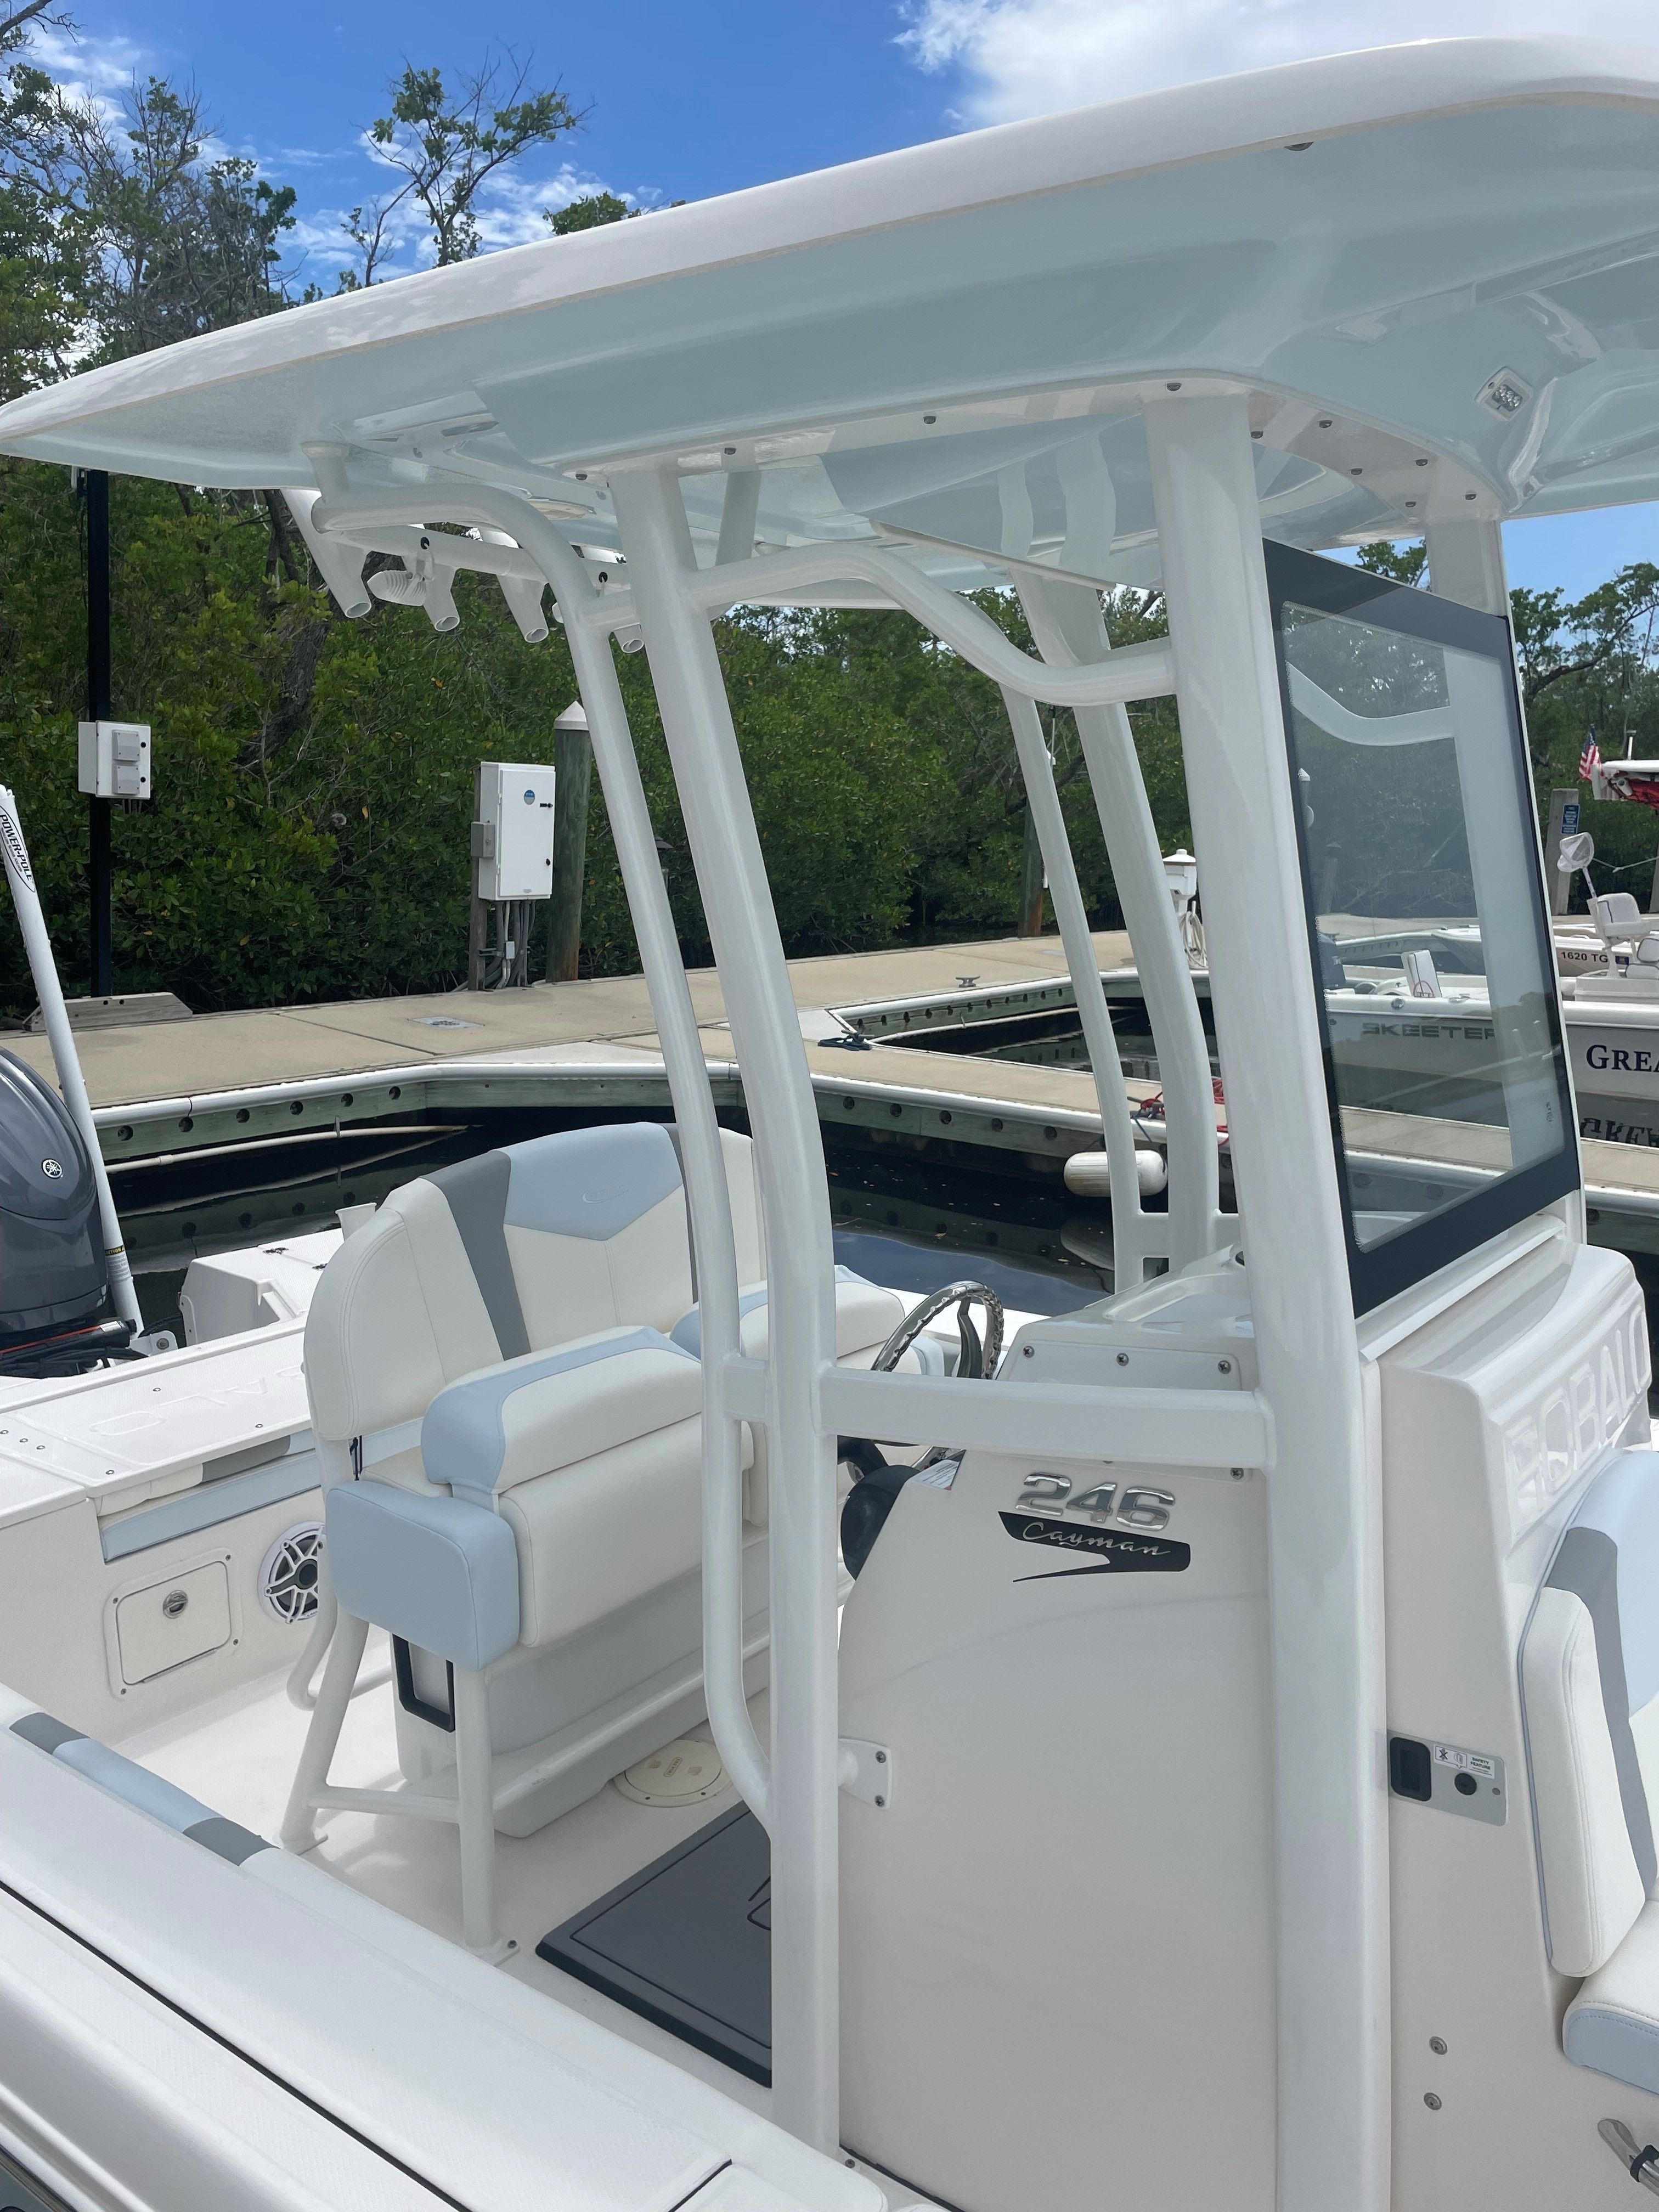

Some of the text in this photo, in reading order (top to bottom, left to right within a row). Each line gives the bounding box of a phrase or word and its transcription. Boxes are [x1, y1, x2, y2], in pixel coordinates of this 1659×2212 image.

[1561, 952, 1608, 963] 1620 TG
[1586, 1045, 1659, 1072] GRE
[1015, 1472, 1176, 1531] 246
[1022, 1522, 1171, 1556] Cayman
